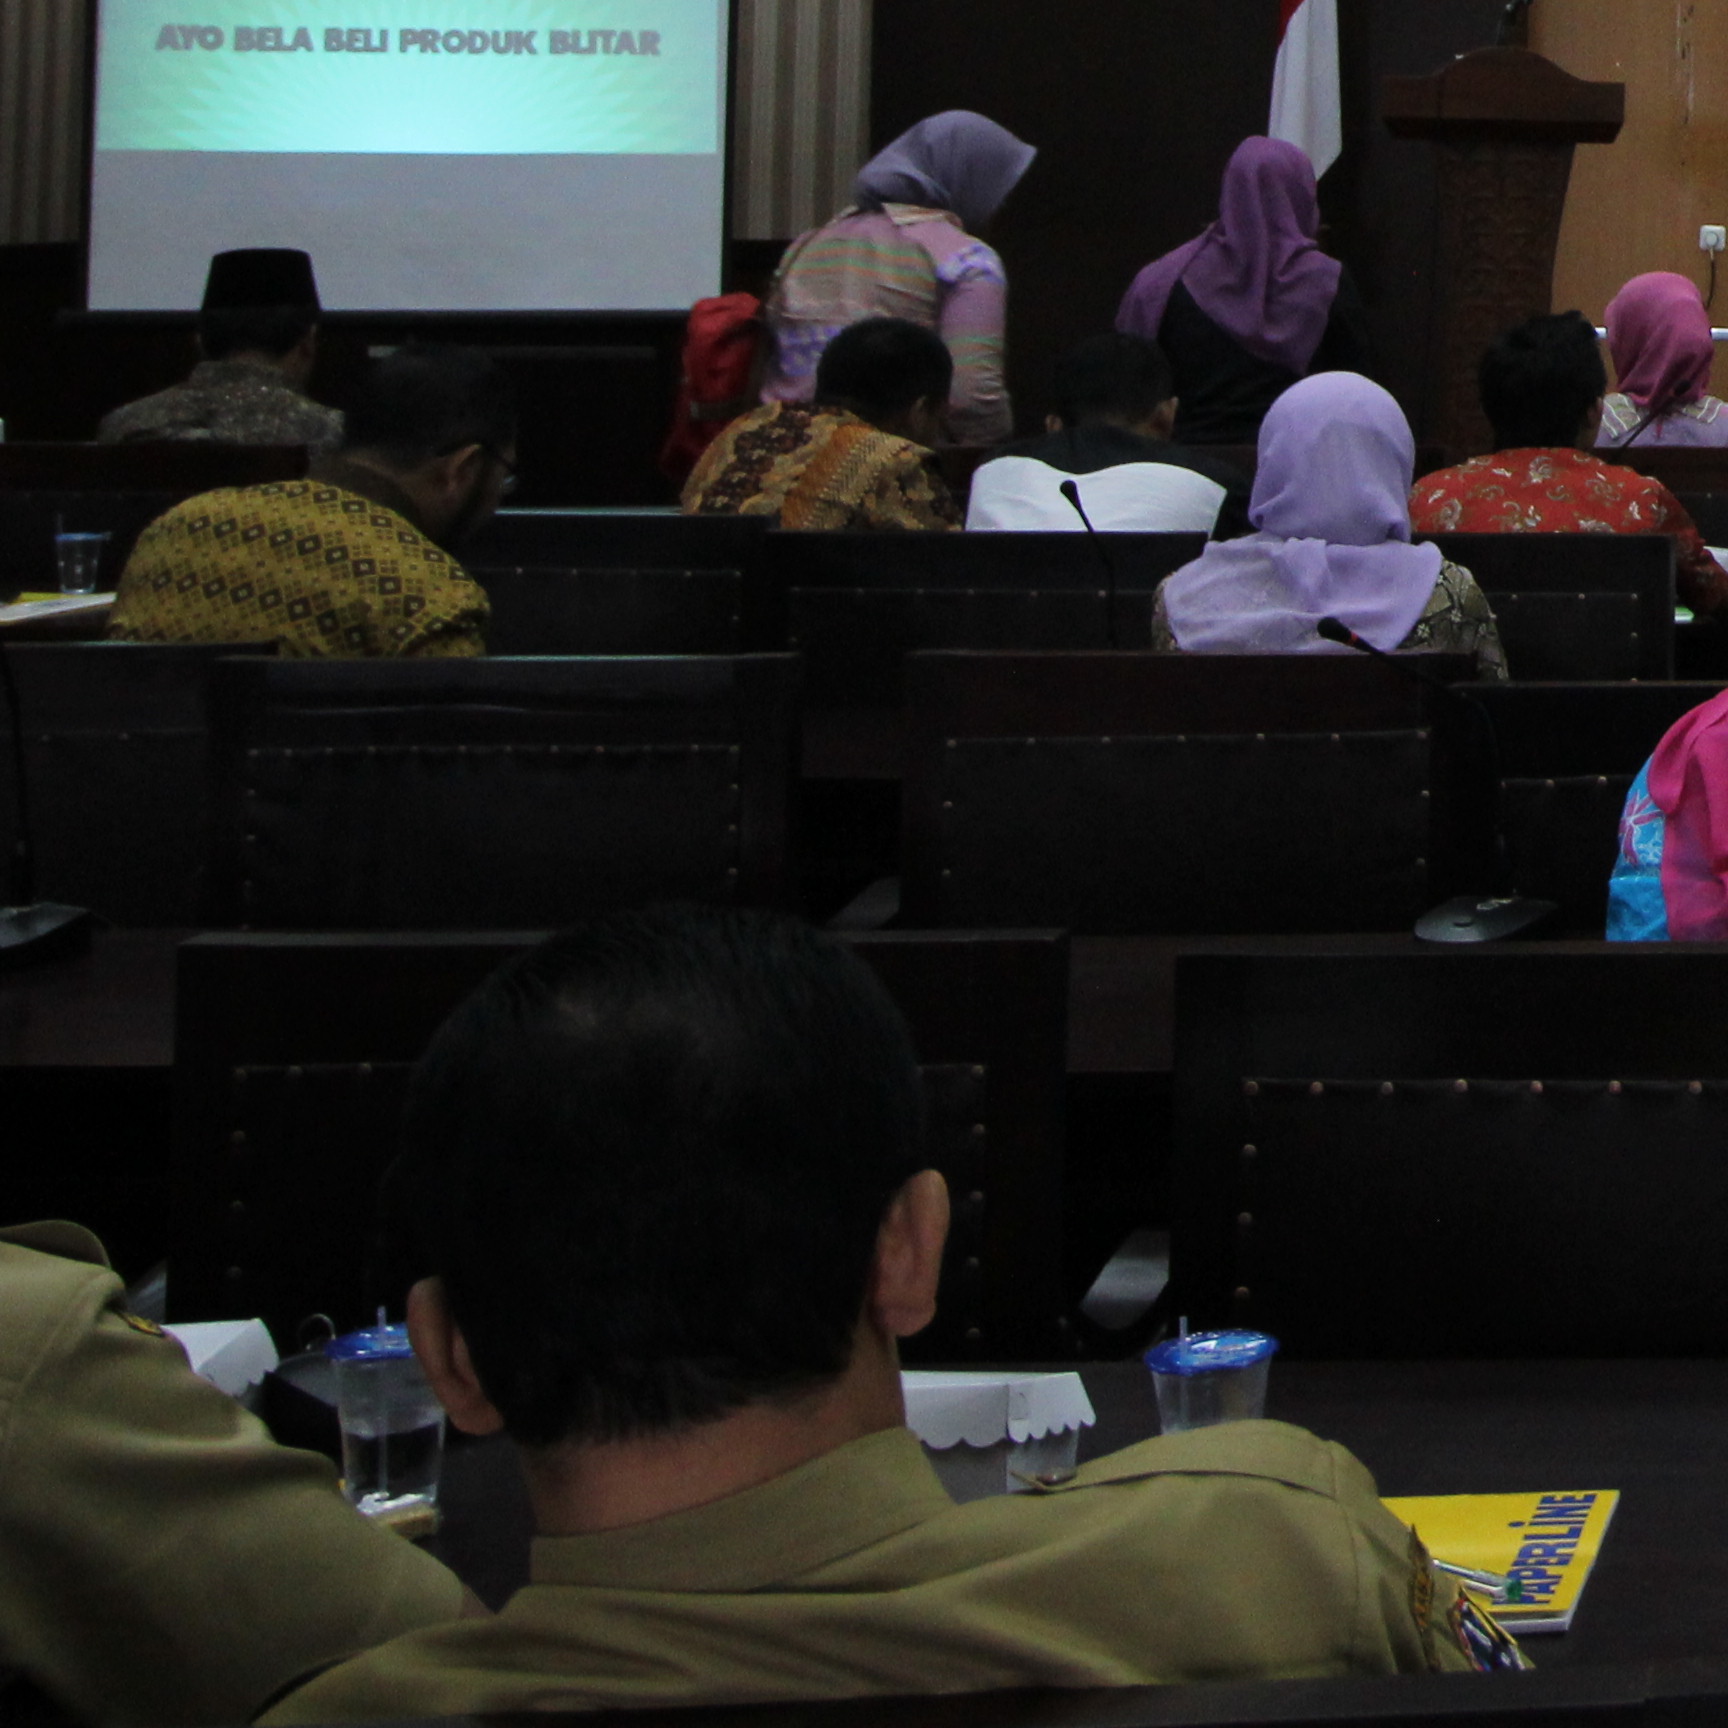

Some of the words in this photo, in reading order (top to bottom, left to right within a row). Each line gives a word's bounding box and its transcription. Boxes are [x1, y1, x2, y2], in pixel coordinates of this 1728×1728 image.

[155, 24, 225, 52] AYO
[234, 26, 314, 53] BELA
[324, 27, 389, 54] BELI
[400, 28, 539, 56] PRODUK
[549, 30, 661, 57] BLITAR
